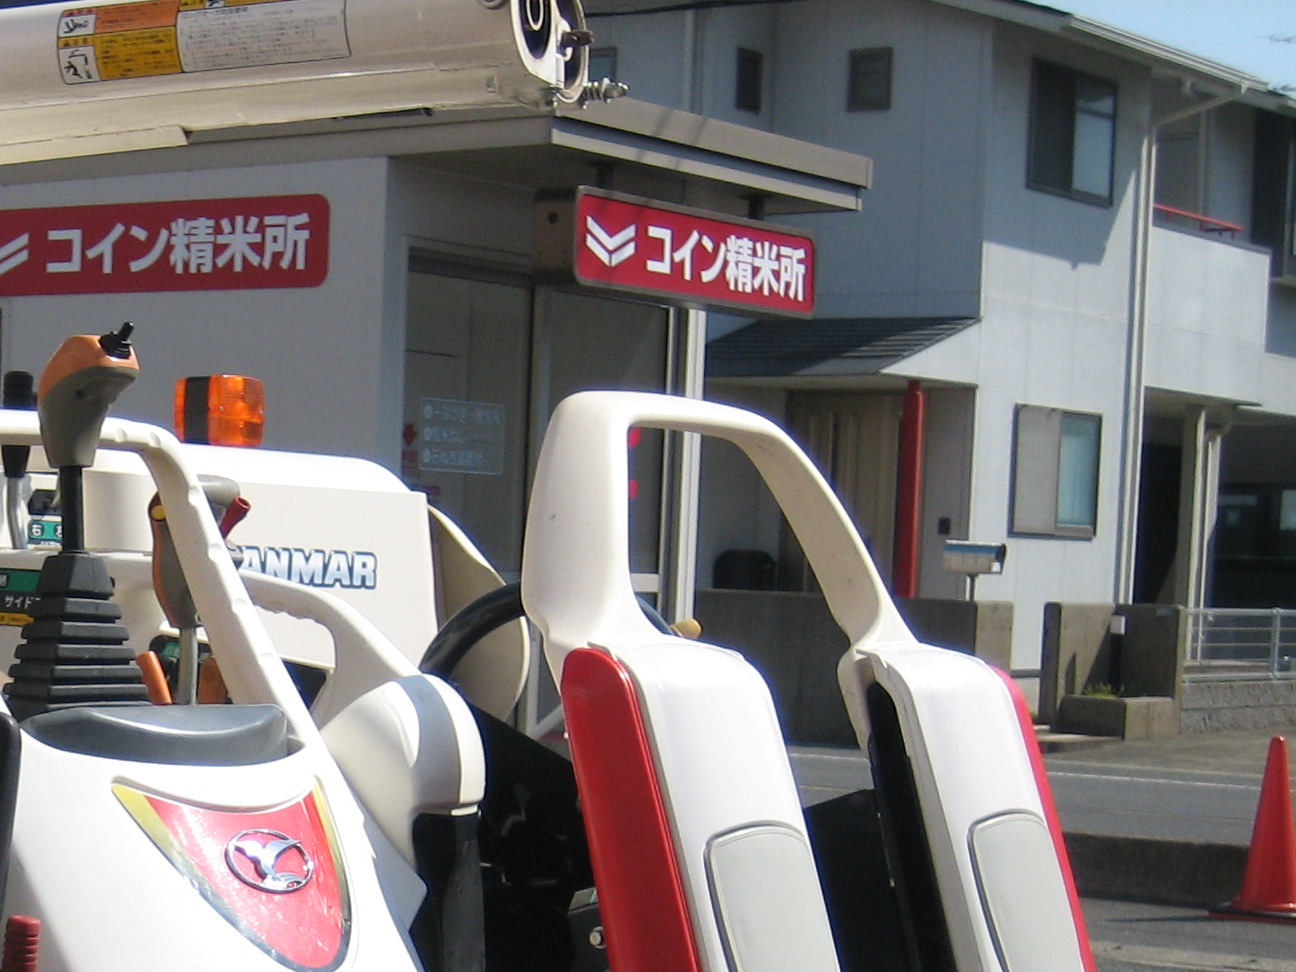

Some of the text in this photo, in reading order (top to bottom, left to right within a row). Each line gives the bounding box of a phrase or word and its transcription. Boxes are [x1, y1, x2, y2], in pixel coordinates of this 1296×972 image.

[46, 212, 309, 274] コイン精米所
[646, 225, 806, 302] コイン精米所
[230, 545, 378, 589] ANMAR
